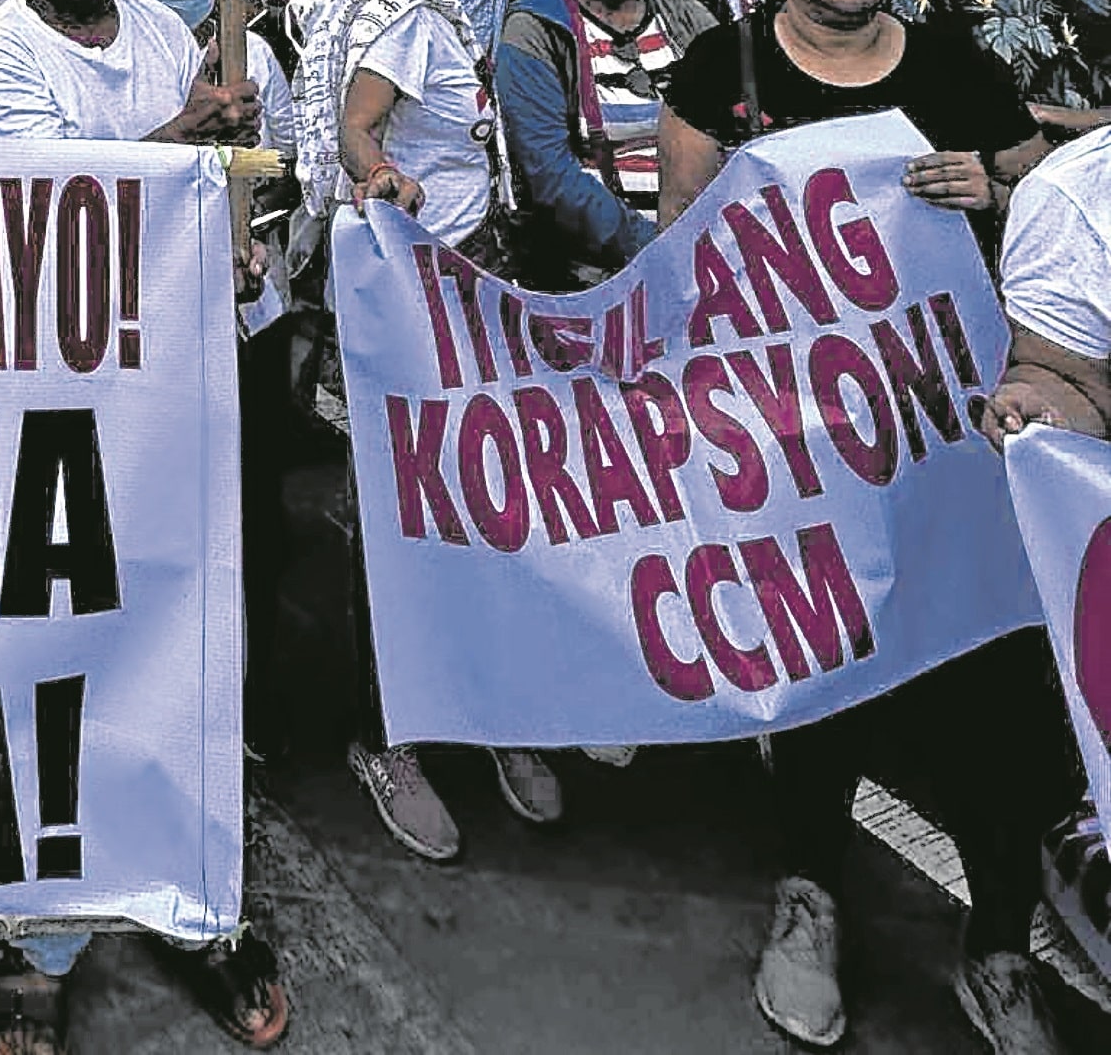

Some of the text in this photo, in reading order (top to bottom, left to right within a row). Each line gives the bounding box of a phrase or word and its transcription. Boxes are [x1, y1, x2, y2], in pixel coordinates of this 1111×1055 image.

[689, 166, 900, 346] ANG
[385, 292, 989, 554] KORAPSYON!
[629, 522, 877, 703] CCM
